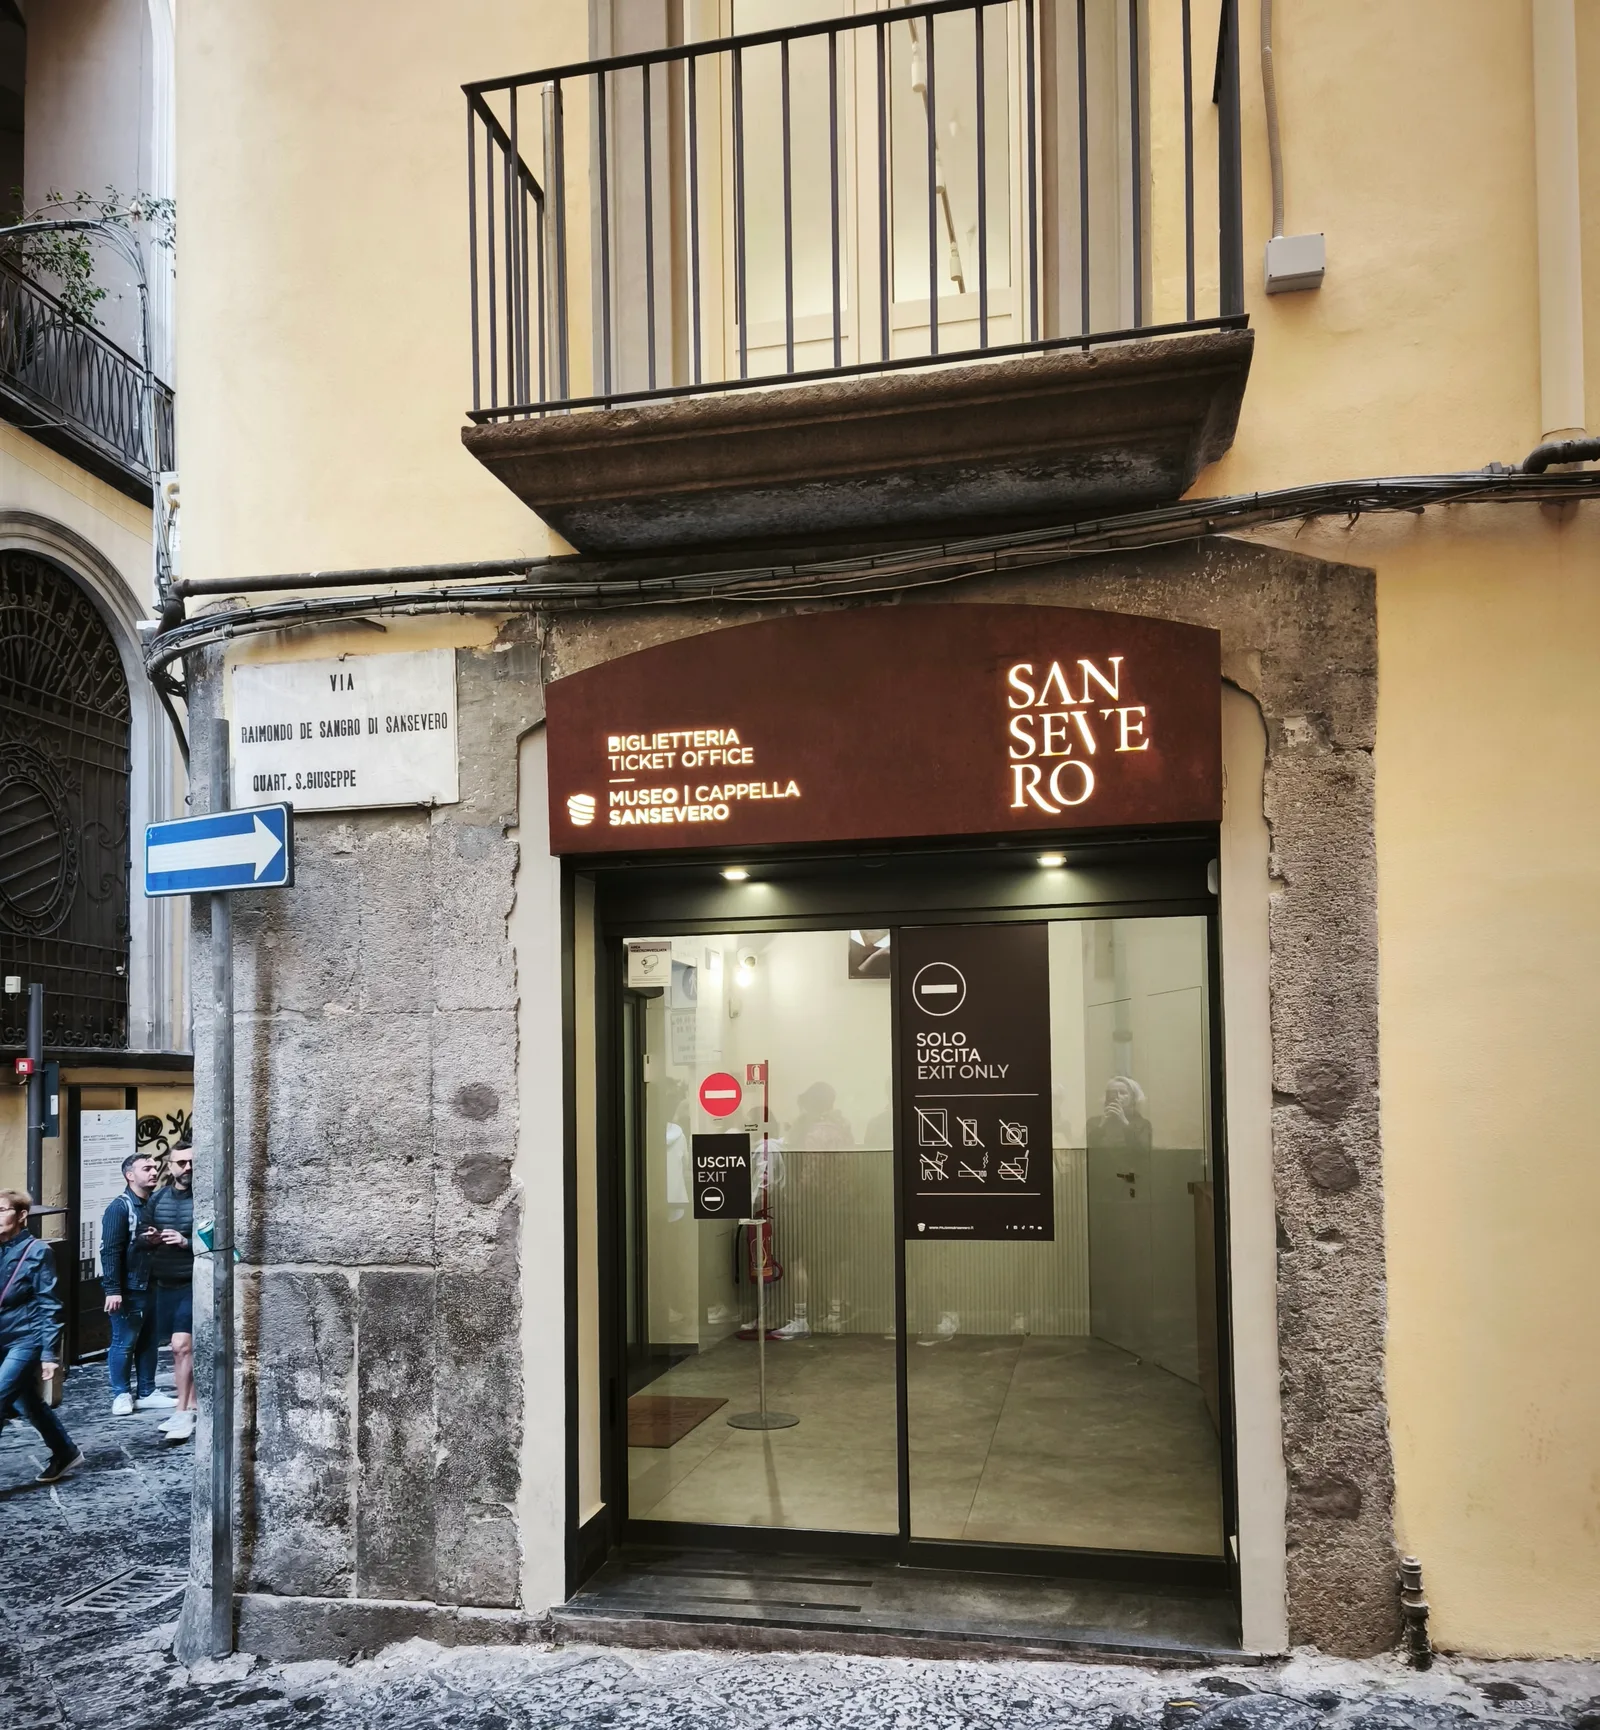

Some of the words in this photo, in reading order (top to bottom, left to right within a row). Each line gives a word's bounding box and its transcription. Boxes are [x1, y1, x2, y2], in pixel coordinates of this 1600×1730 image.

[329, 673, 355, 691] VIA
[1008, 656, 1124, 709] SAN
[241, 723, 293, 743] RAIMONDO
[300, 722, 313, 739] DE
[319, 718, 361, 738] SANGRO
[368, 717, 378, 734] DI
[386, 712, 448, 733] SANSEVERO
[1009, 706, 1149, 759] SEVE
[607, 728, 740, 752] BIGLIETTERIA
[608, 752, 676, 771] TICKET
[681, 747, 754, 768] OFFICE
[253, 773, 292, 792] QUART.
[609, 787, 678, 807] MUSEO
[695, 780, 801, 802] CAPPELLA
[1010, 760, 1095, 813] RO
[609, 803, 730, 826] SANSEVERO
[916, 1031, 966, 1047] SOLO
[917, 1048, 982, 1063] USCITA
[918, 1065, 956, 1080] EXIT
[959, 1064, 1009, 1079] ONLY
[697, 1156, 746, 1168] USCITA
[698, 1171, 727, 1183] EXIT
